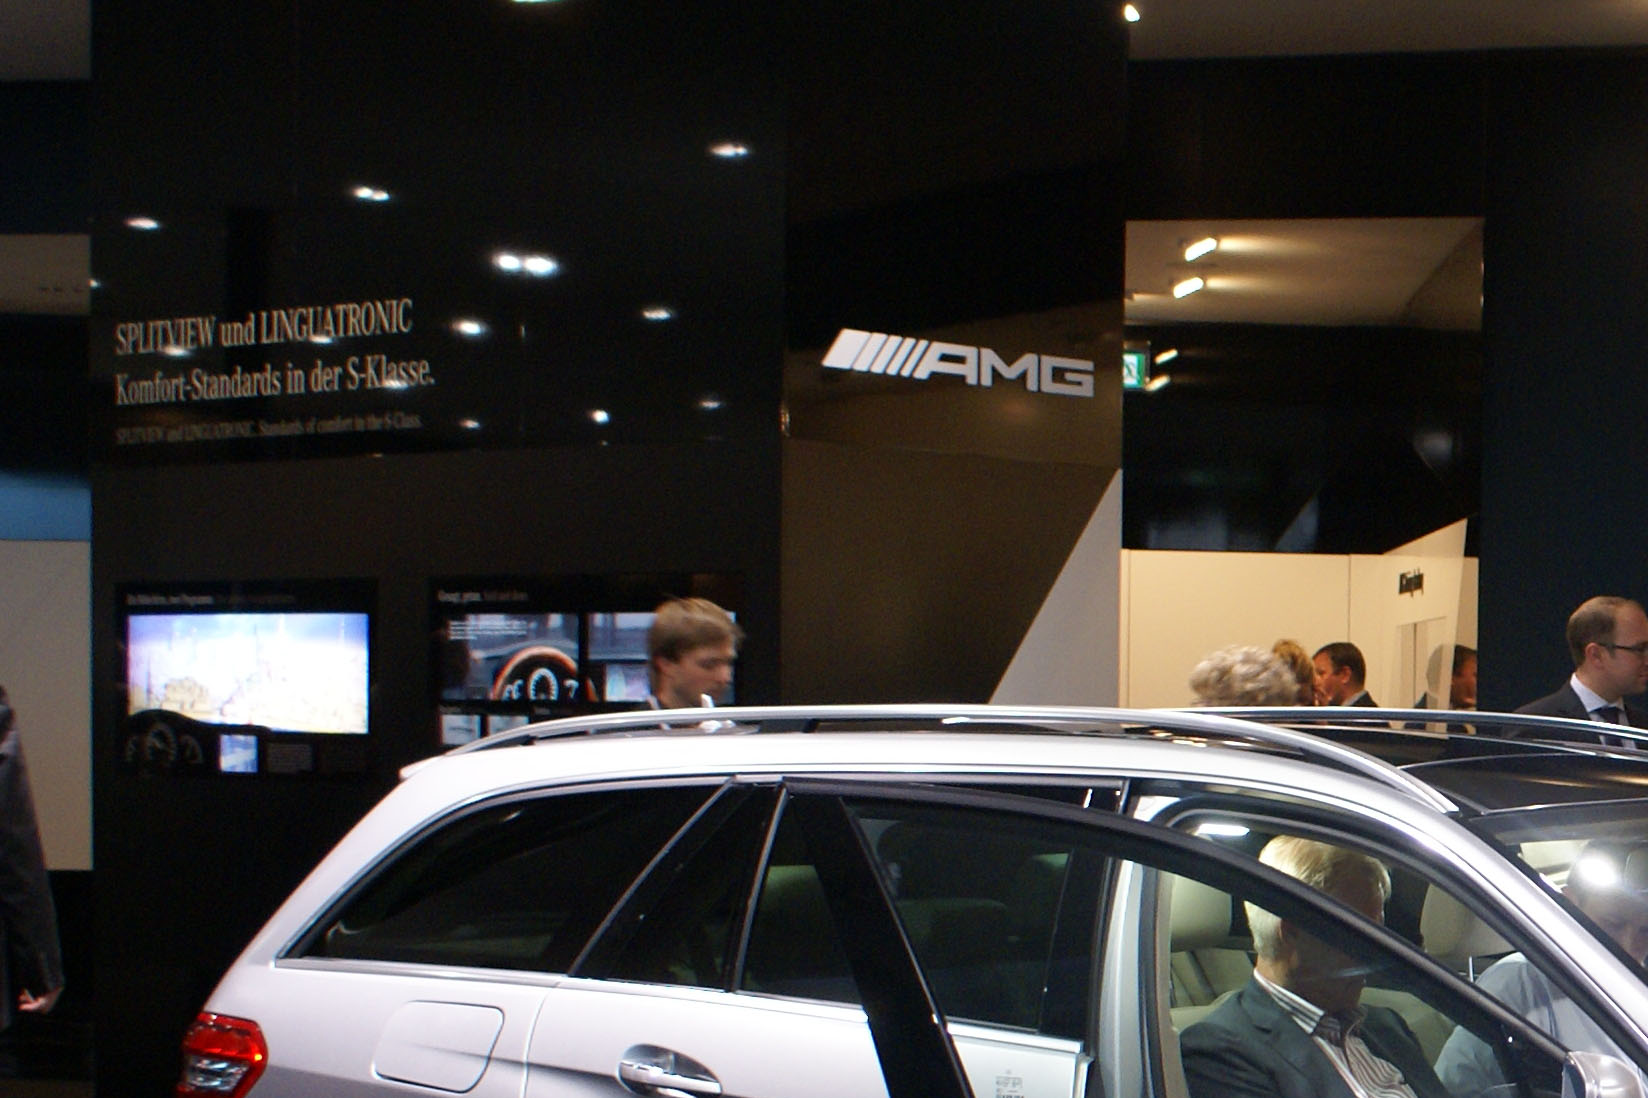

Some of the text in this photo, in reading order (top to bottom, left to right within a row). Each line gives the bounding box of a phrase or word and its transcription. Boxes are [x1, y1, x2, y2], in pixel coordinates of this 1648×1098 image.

[115, 298, 413, 355] SPLITVIEW und LINGUATRONIC
[115, 354, 436, 406] Komfort-Standards in der S-Klasse.
[912, 341, 1095, 398] AMG
